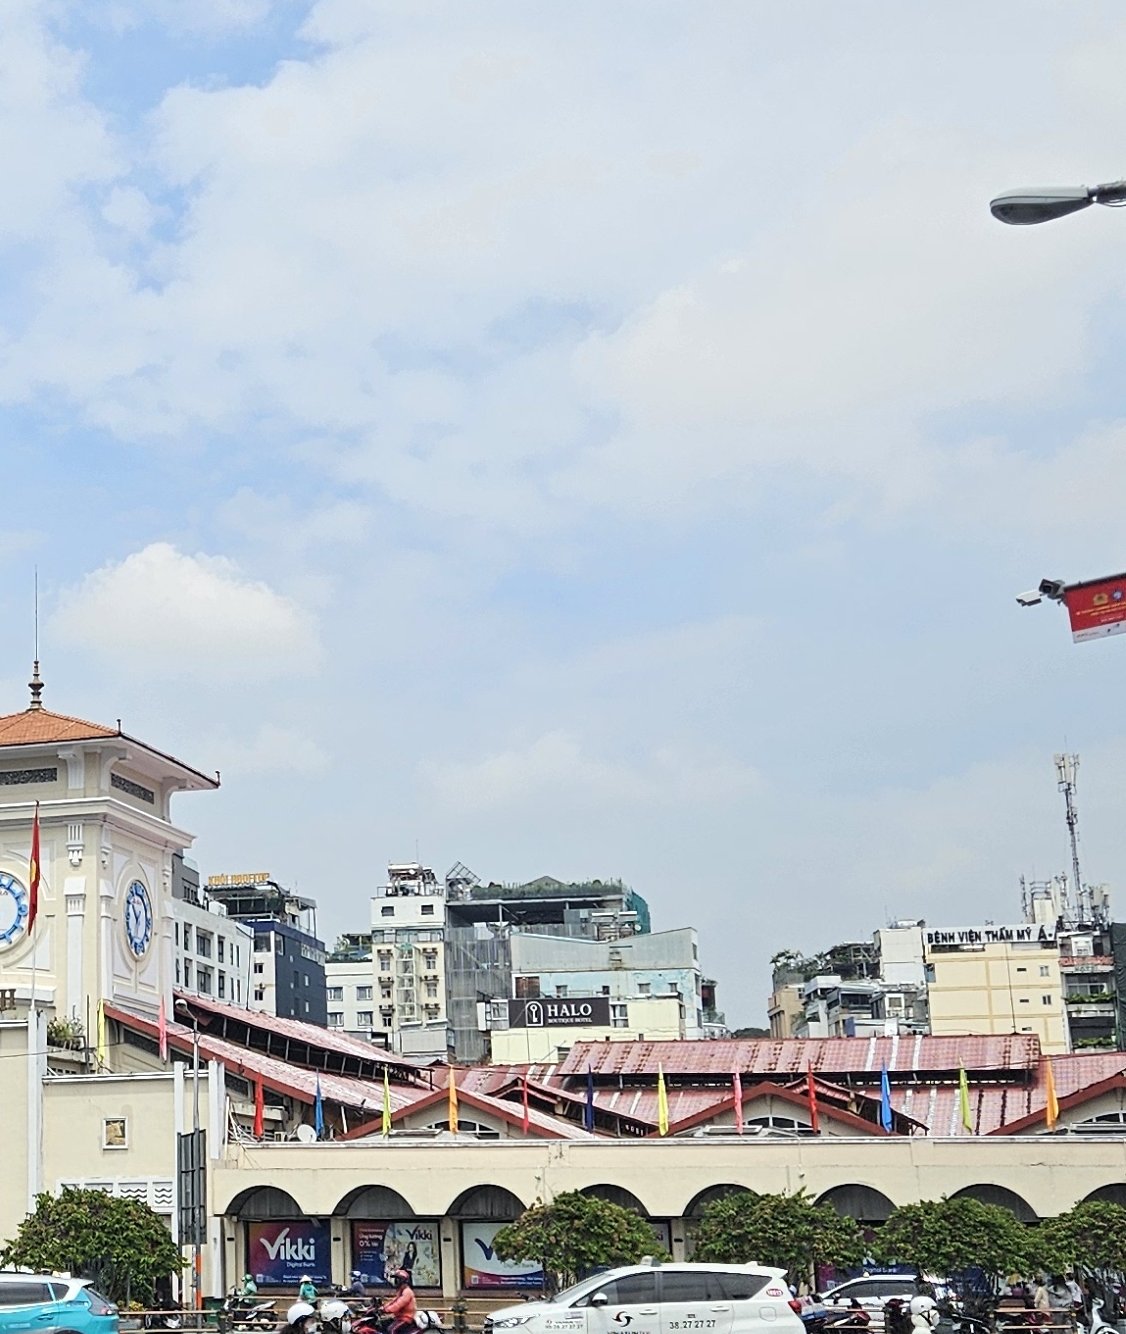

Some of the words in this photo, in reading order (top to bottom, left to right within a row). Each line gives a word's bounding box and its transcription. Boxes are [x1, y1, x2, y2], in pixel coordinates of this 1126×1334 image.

[927, 930, 955, 944] BỆNH
[959, 929, 982, 945] VIỆN
[547, 1003, 592, 1017] HALO
[405, 1225, 432, 1241] Vikki
[260, 1228, 316, 1260] Vikki
